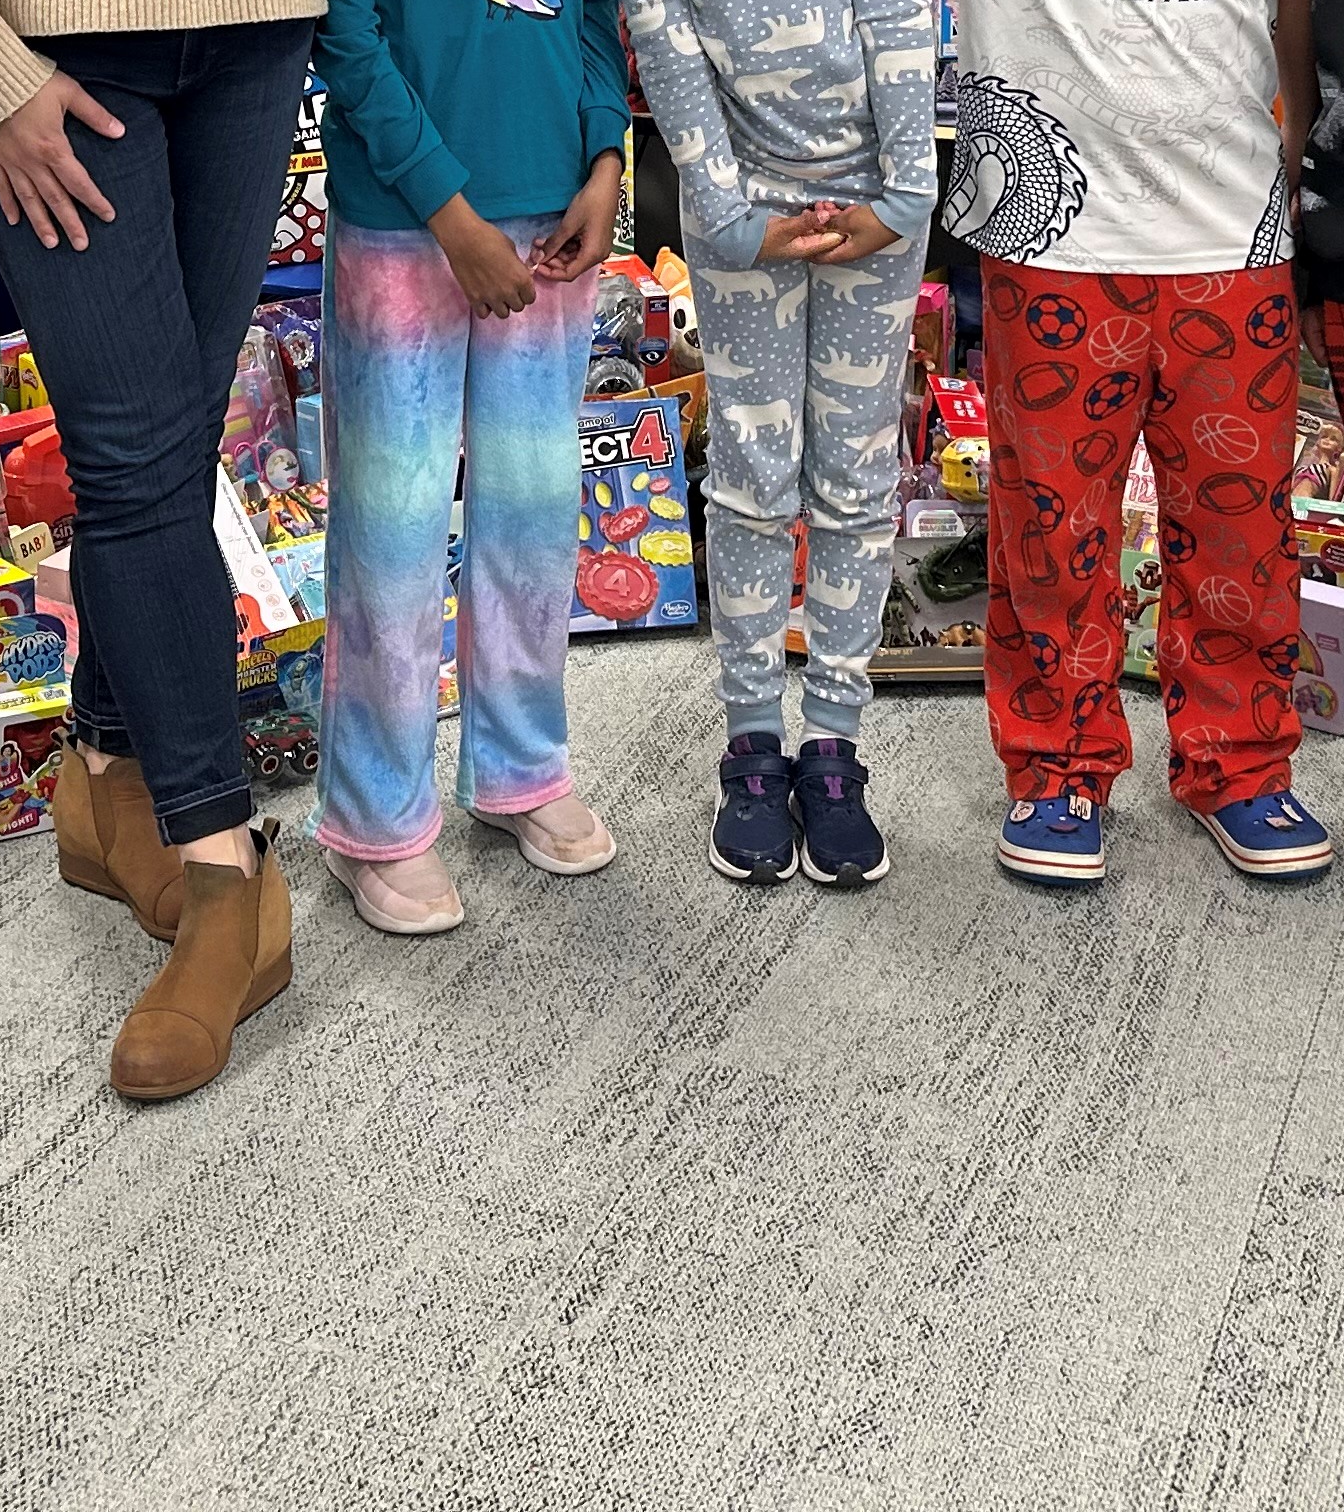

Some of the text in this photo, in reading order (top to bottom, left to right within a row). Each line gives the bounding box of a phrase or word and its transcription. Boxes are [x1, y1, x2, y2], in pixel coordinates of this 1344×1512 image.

[20, 532, 48, 558] BABY
[2, 632, 66, 667] HYDRO
[8, 651, 64, 684] PODS
[237, 661, 278, 678] MONSTER
[237, 670, 279, 693] TRUCKS
